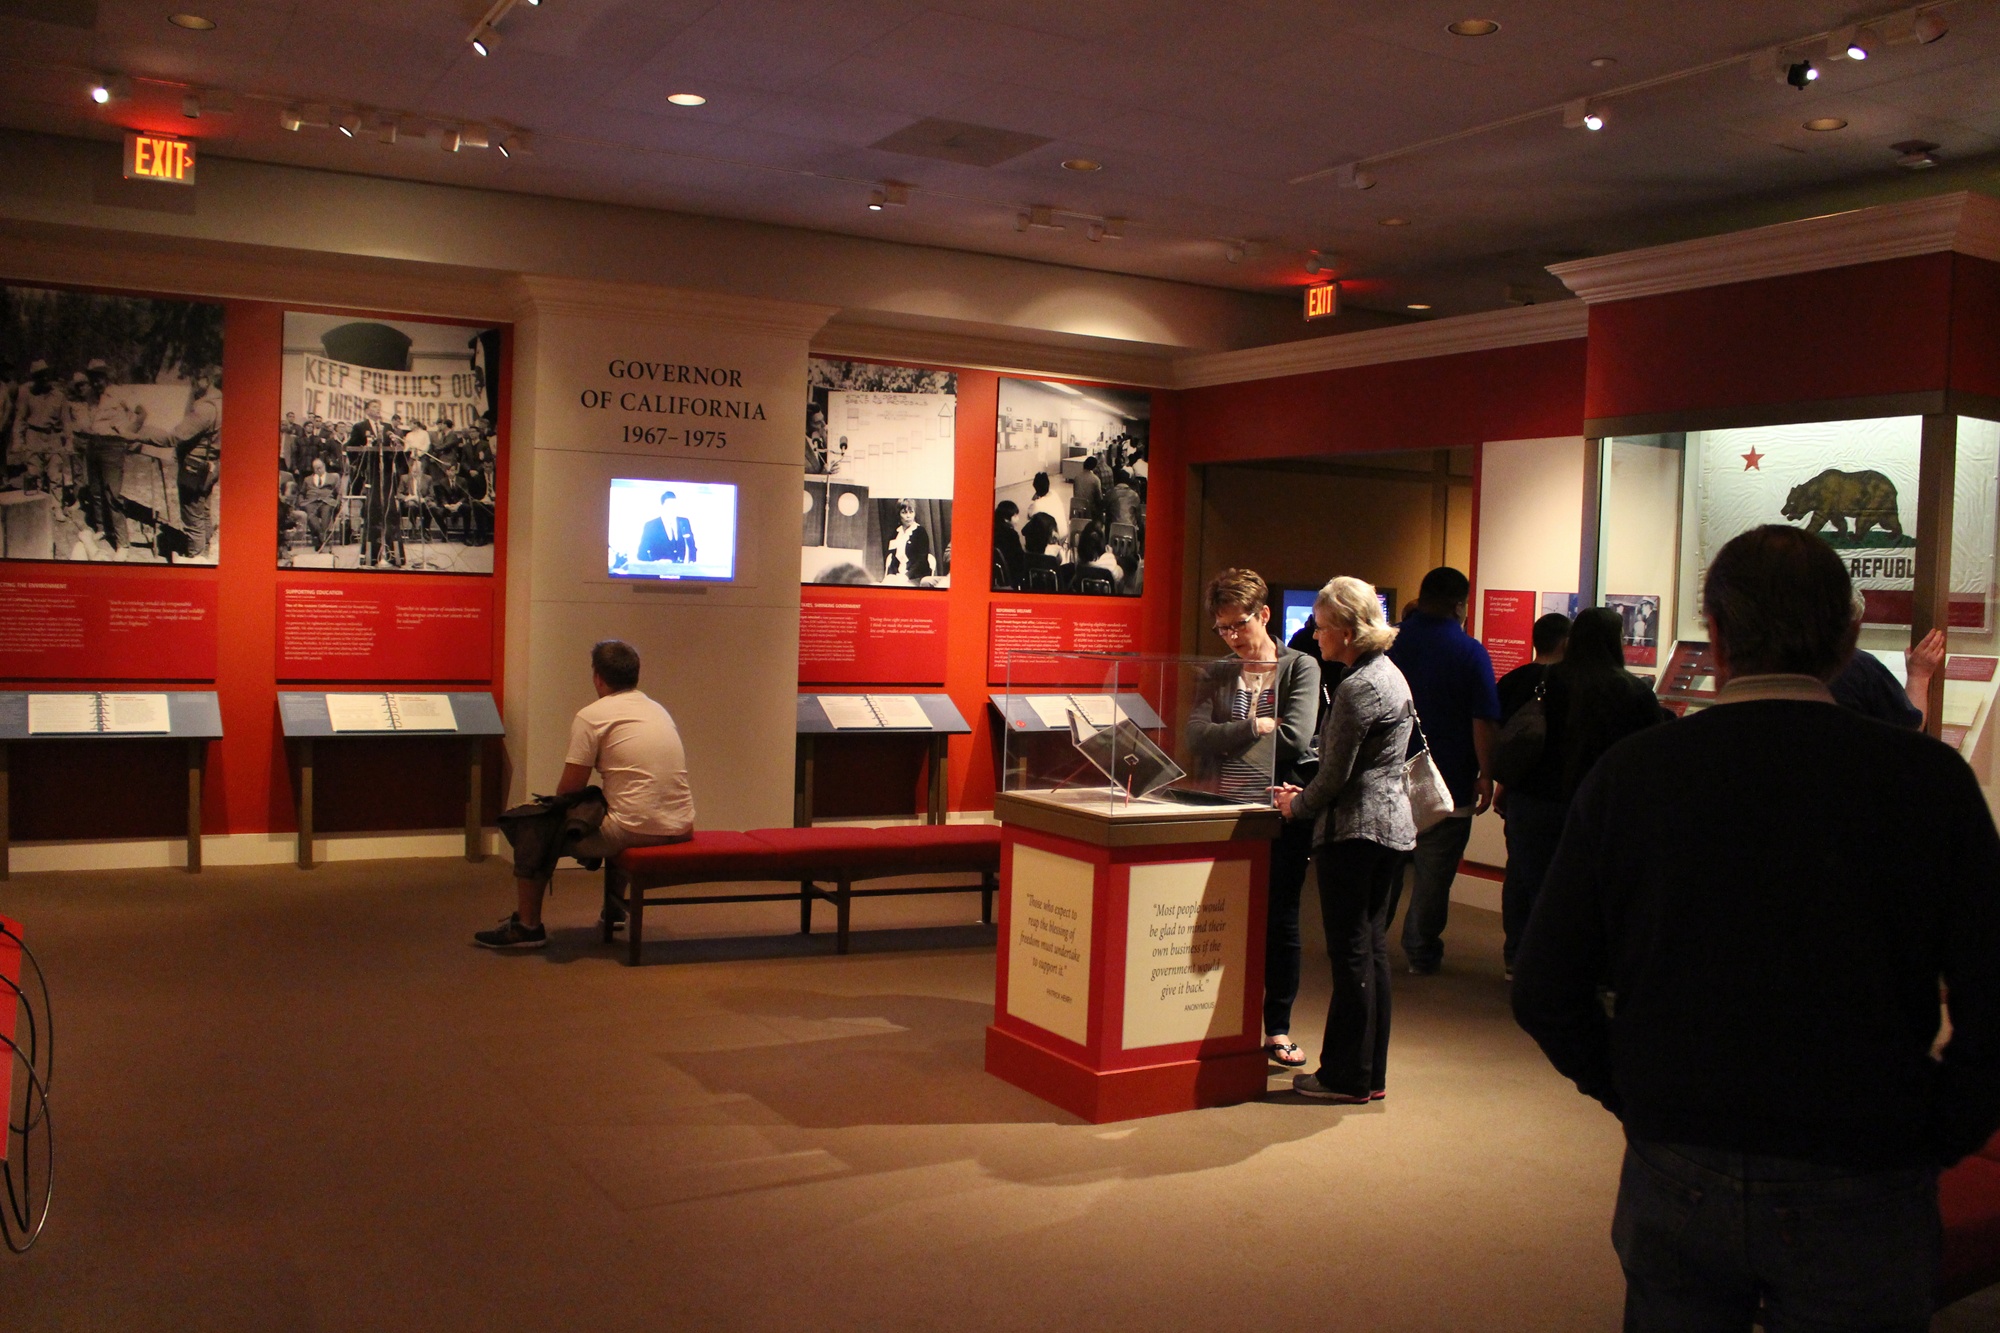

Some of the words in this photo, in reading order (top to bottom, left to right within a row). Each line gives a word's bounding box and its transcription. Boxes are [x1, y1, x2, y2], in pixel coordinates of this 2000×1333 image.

[135, 137, 188, 179] EXIT
[1309, 286, 1333, 316] EXIT
[305, 356, 350, 388] KEEP
[361, 369, 441, 398] POLITICS
[608, 359, 743, 388] GOVERNOR
[394, 401, 478, 428] EDUCATIO
[580, 389, 613, 409] OF
[620, 392, 767, 421] CALIFORNIA
[1851, 558, 1915, 578] REPUBL
[1043, 900, 1054, 913] who
[1054, 906, 1071, 919] expect
[1071, 909, 1077, 920] to
[1176, 901, 1200, 919] people
[1202, 899, 1225, 912] would
[1028, 917, 1039, 931] reap
[1040, 917, 1048, 931] the
[1049, 920, 1069, 942] blessing
[1069, 928, 1076, 944] of
[1149, 924, 1158, 937] be
[1159, 922, 1176, 940] glad
[1178, 924, 1185, 935] to
[1187, 920, 1207, 934] mind
[1209, 920, 1226, 932] their
[1019, 930, 1040, 948] freedom
[1040, 941, 1053, 952] must
[1054, 945, 1080, 962] undertake
[1152, 947, 1168, 957] own
[1170, 943, 1200, 955] business
[1202, 940, 1208, 957] if
[1210, 939, 1221, 952] the
[1033, 958, 1038, 967] to
[1039, 960, 1057, 975] support
[1150, 963, 1196, 981] government
[1197, 959, 1220, 973] would
[1160, 984, 1176, 1000] give
[1178, 983, 1184, 994] it
[1184, 1002, 1215, 1011] ANONYMOUS
